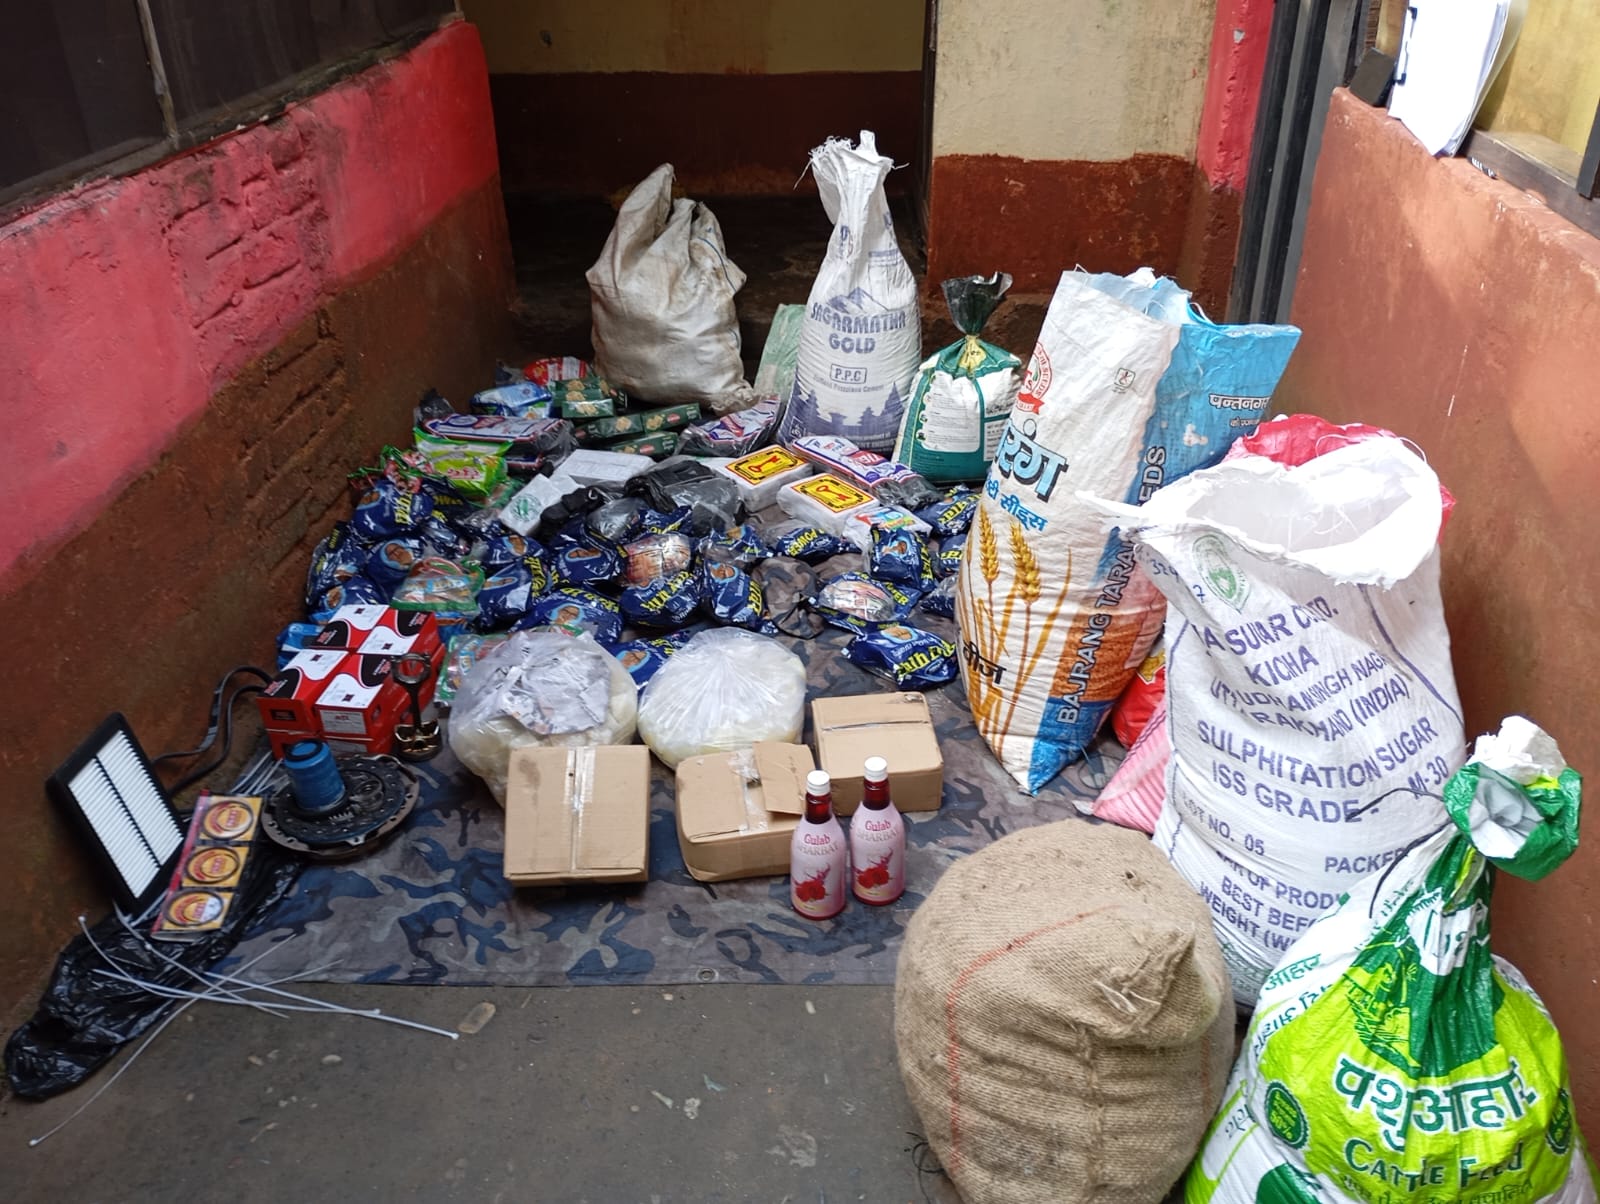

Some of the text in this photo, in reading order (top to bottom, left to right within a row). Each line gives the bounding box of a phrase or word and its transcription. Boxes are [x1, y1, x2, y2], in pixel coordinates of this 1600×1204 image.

[829, 333, 876, 353] GOLD
[834, 367, 862, 382] P.P.C
[1056, 613, 1112, 725] BAJRANG
[1137, 446, 1166, 506] EDS
[1350, 673, 1411, 727] (INDIA)
[1197, 716, 1438, 789] SULPHITATION SUGAR
[1254, 782, 1362, 823] GRADE
[1407, 755, 1449, 800] M-30
[804, 834, 831, 846] Gulab
[864, 820, 891, 832] Gulab
[1245, 834, 1265, 856] 05
[1222, 876, 1264, 917] BEST
[1276, 881, 1341, 910] PROD
[1199, 881, 1297, 952] WEIGHT (W
[1345, 1139, 1445, 1192] CATTLE
